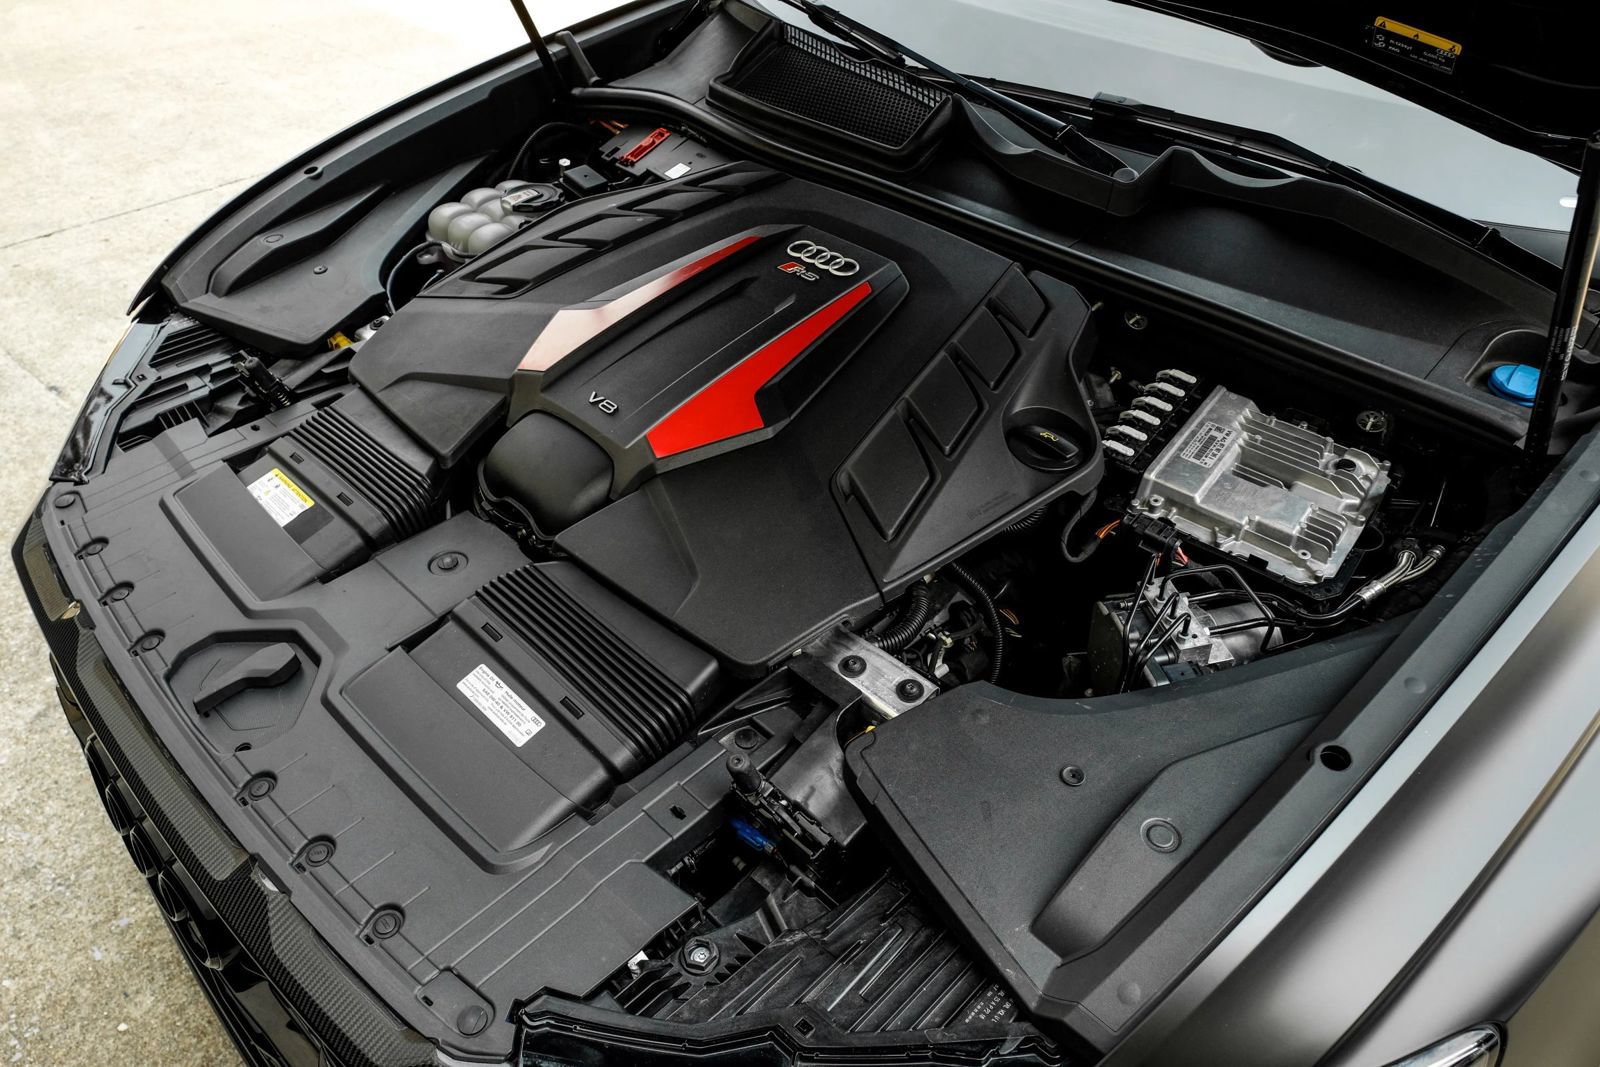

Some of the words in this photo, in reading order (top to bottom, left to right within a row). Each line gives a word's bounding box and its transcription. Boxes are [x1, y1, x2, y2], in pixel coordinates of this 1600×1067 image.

[785, 264, 820, 281] RS
[588, 391, 617, 414] V8
[479, 666, 490, 676] Engine
[504, 690, 513, 699] Huile
[512, 698, 525, 711] moteur
